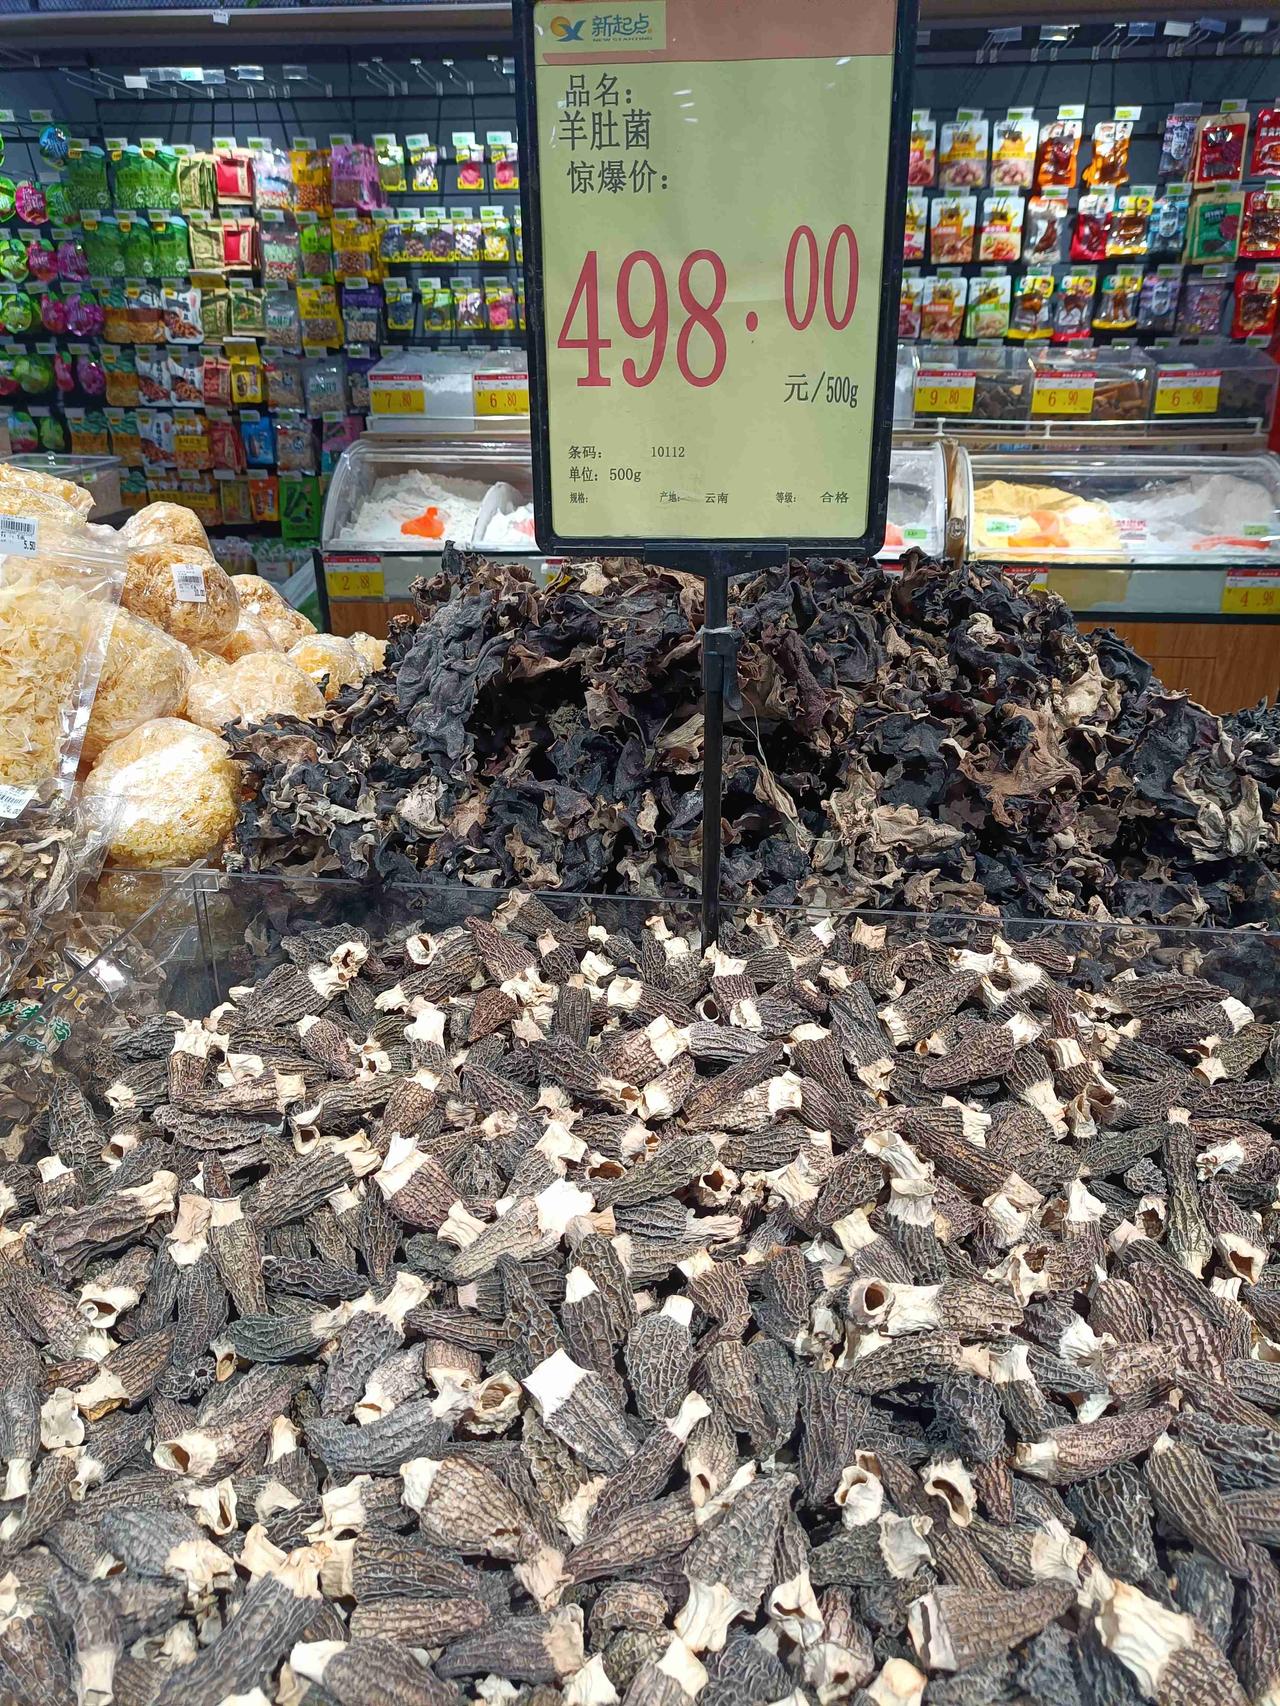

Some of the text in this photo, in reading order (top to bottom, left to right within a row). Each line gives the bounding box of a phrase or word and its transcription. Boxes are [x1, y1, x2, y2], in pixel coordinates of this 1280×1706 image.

[592, 12, 650, 36] 新起点
[565, 73, 633, 108] 品名：
[558, 109, 652, 151] 羊肚菌
[566, 159, 669, 194] 惊爆价：
[784, 371, 859, 408] 元/500g
[568, 445, 685, 460] 条码： 10112
[568, 466, 642, 483] 单位： 500g
[704, 492, 729, 504] 云南
[819, 491, 850, 504] 合格
